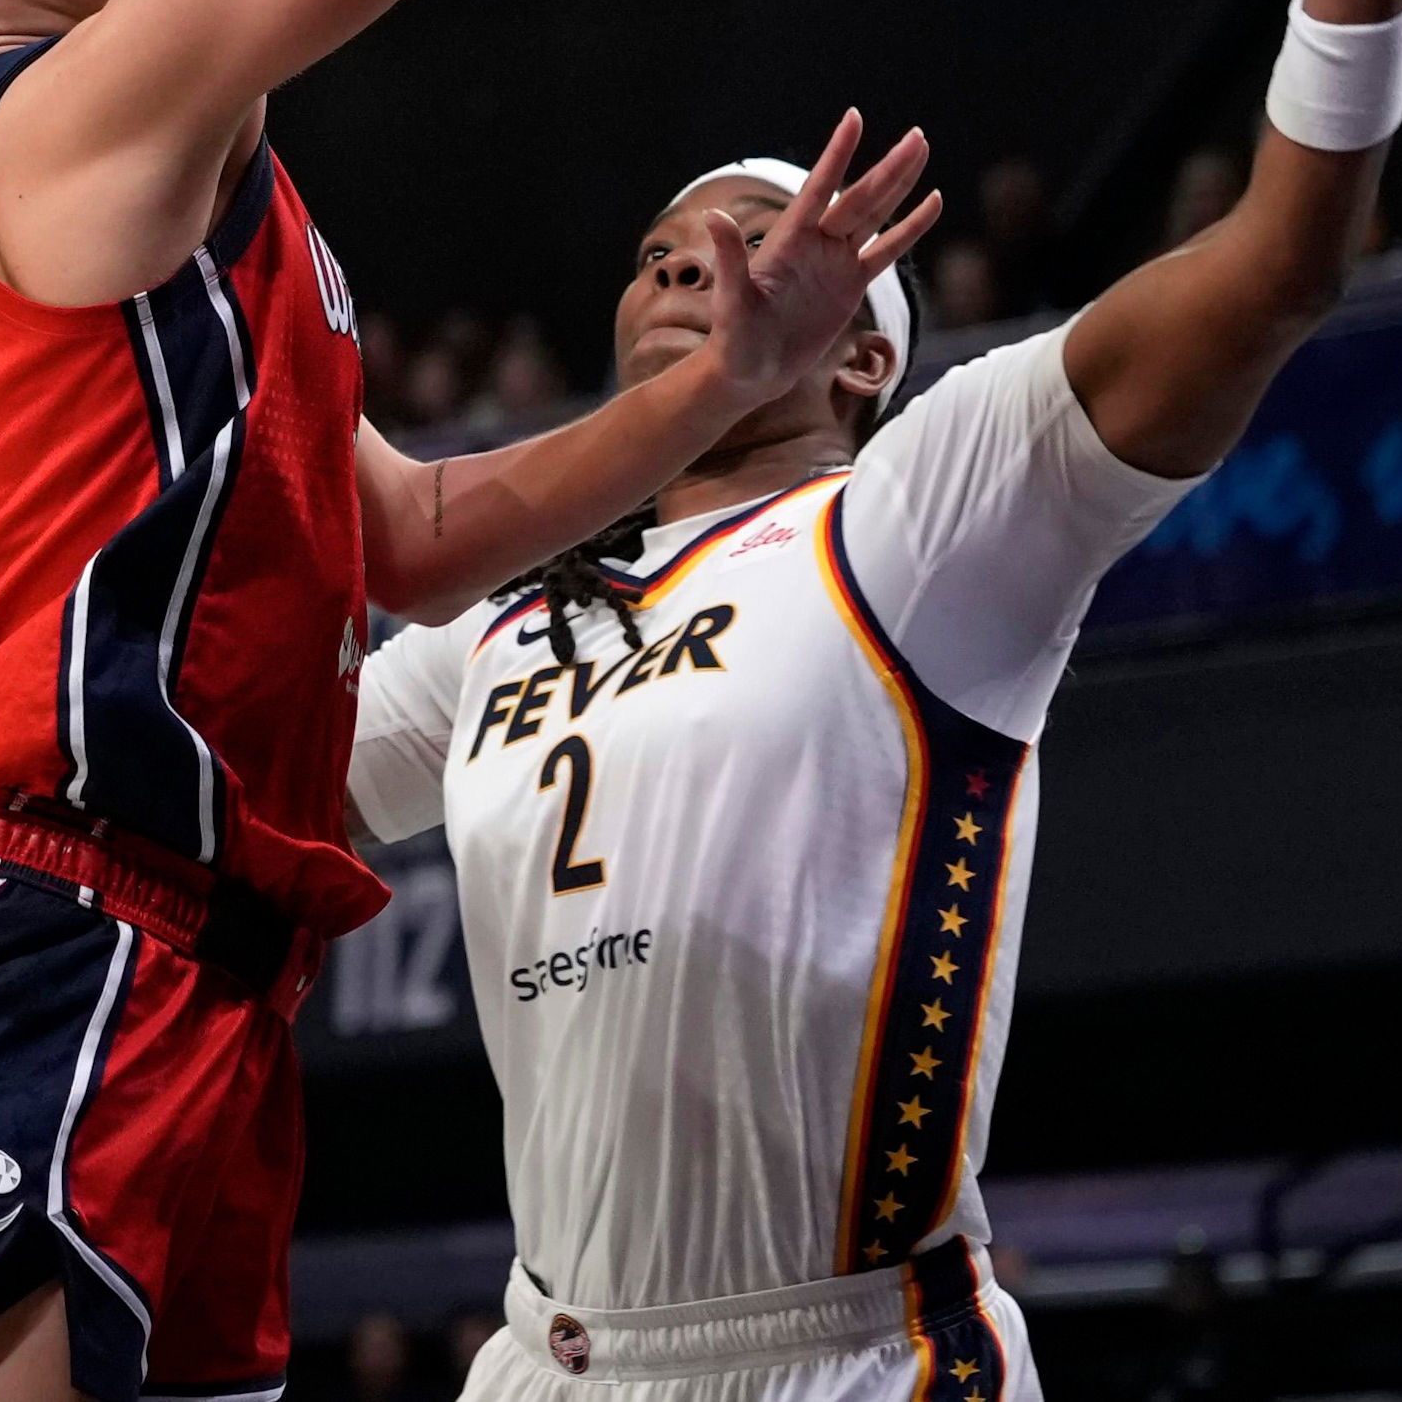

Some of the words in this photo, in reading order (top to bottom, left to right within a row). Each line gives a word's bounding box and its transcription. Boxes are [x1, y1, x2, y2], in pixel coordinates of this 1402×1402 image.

[466, 603, 737, 766] FEVER
[537, 732, 607, 898] 2
[333, 864, 458, 1038] 112
